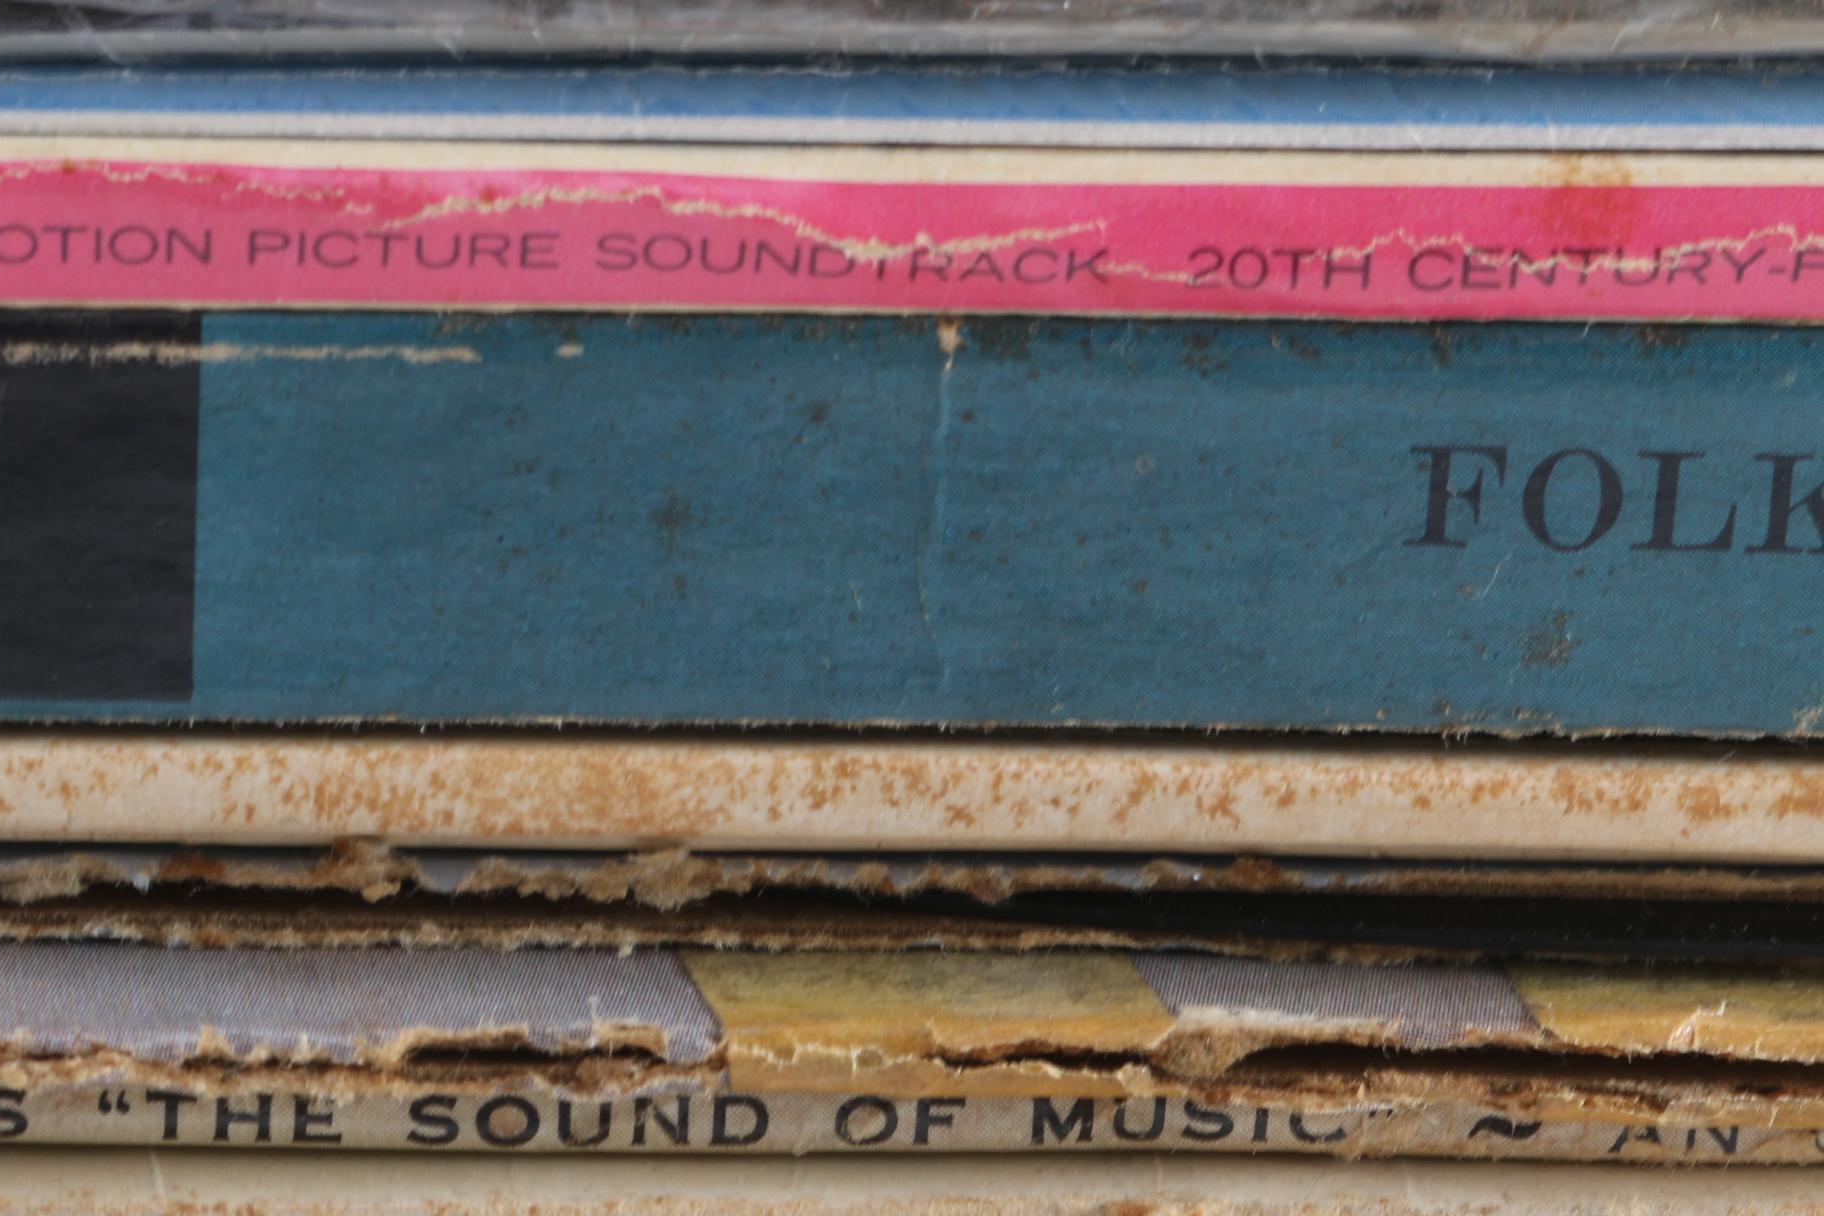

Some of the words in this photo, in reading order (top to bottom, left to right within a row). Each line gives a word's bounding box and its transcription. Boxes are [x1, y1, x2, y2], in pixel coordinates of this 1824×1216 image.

[248, 227, 561, 269] PICTURE
[595, 231, 1110, 284] SOUNDTRACK
[1186, 246, 1371, 290] 20TH
[1402, 442, 1824, 555] FOLK
[406, 1093, 771, 1148] SOUND
[834, 1095, 967, 1147] OF
